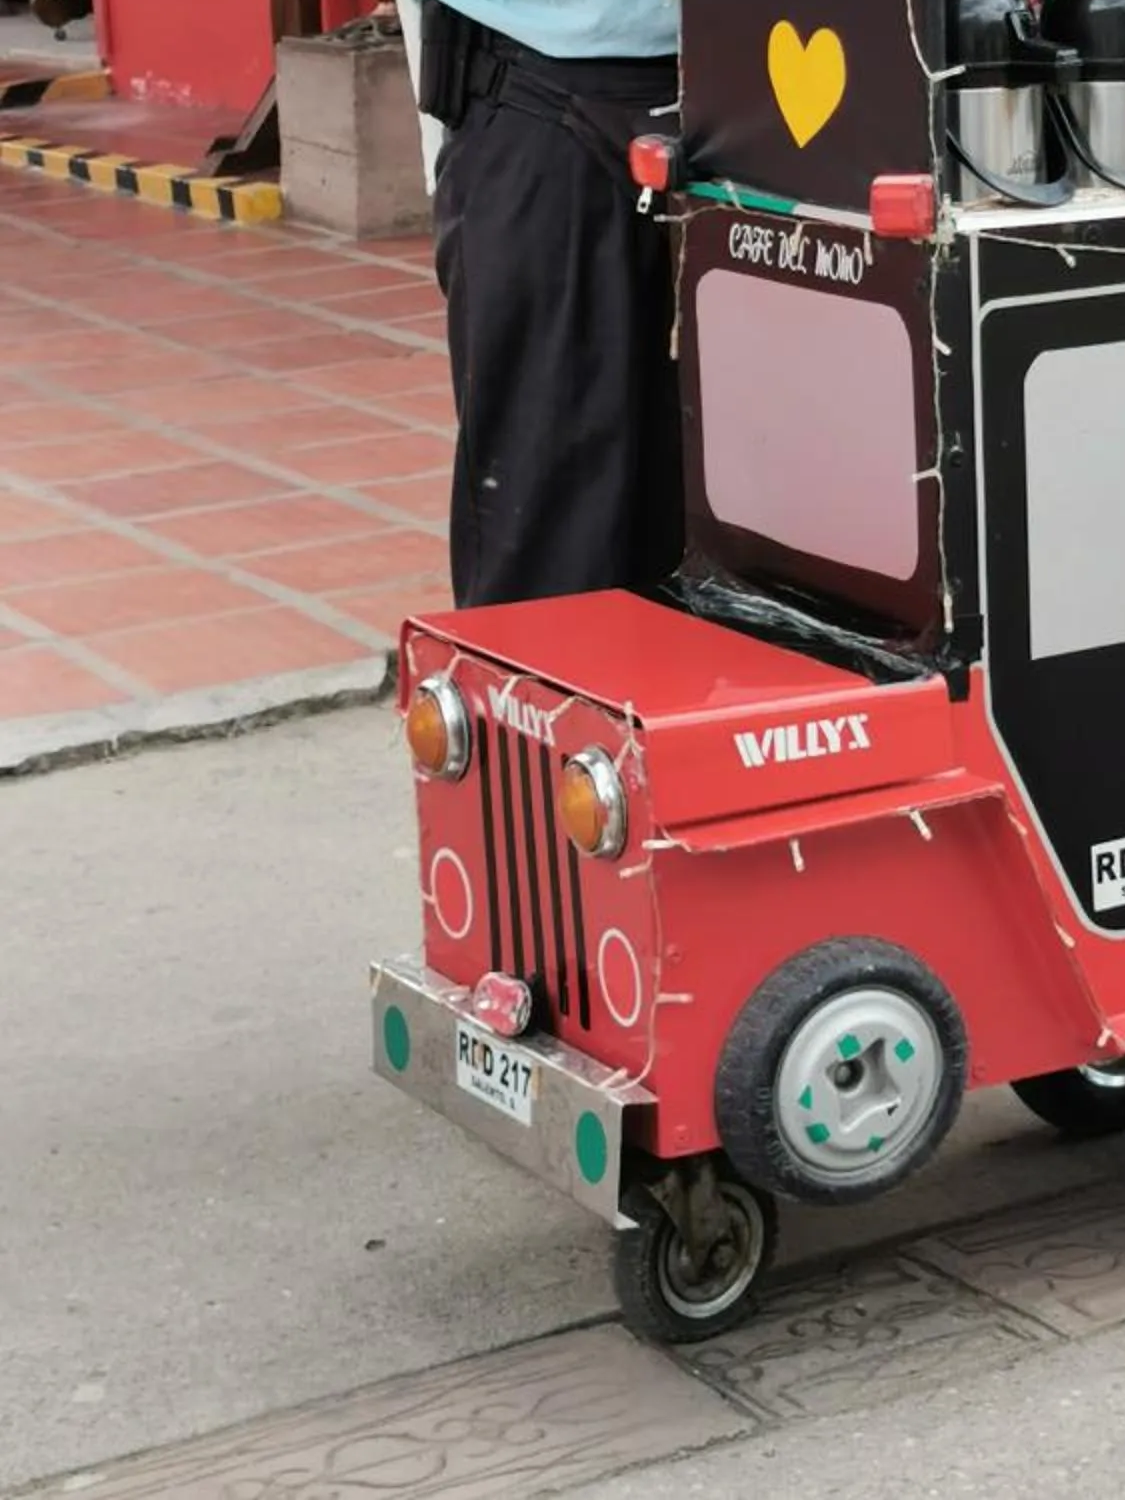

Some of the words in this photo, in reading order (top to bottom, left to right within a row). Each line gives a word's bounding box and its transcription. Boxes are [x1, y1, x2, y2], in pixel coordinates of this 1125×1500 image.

[729, 222, 775, 267] CAFE
[778, 231, 811, 274] DEL
[487, 684, 556, 747] WILLYS
[733, 713, 871, 768] WILLYS
[500, 1053, 532, 1098] 217
